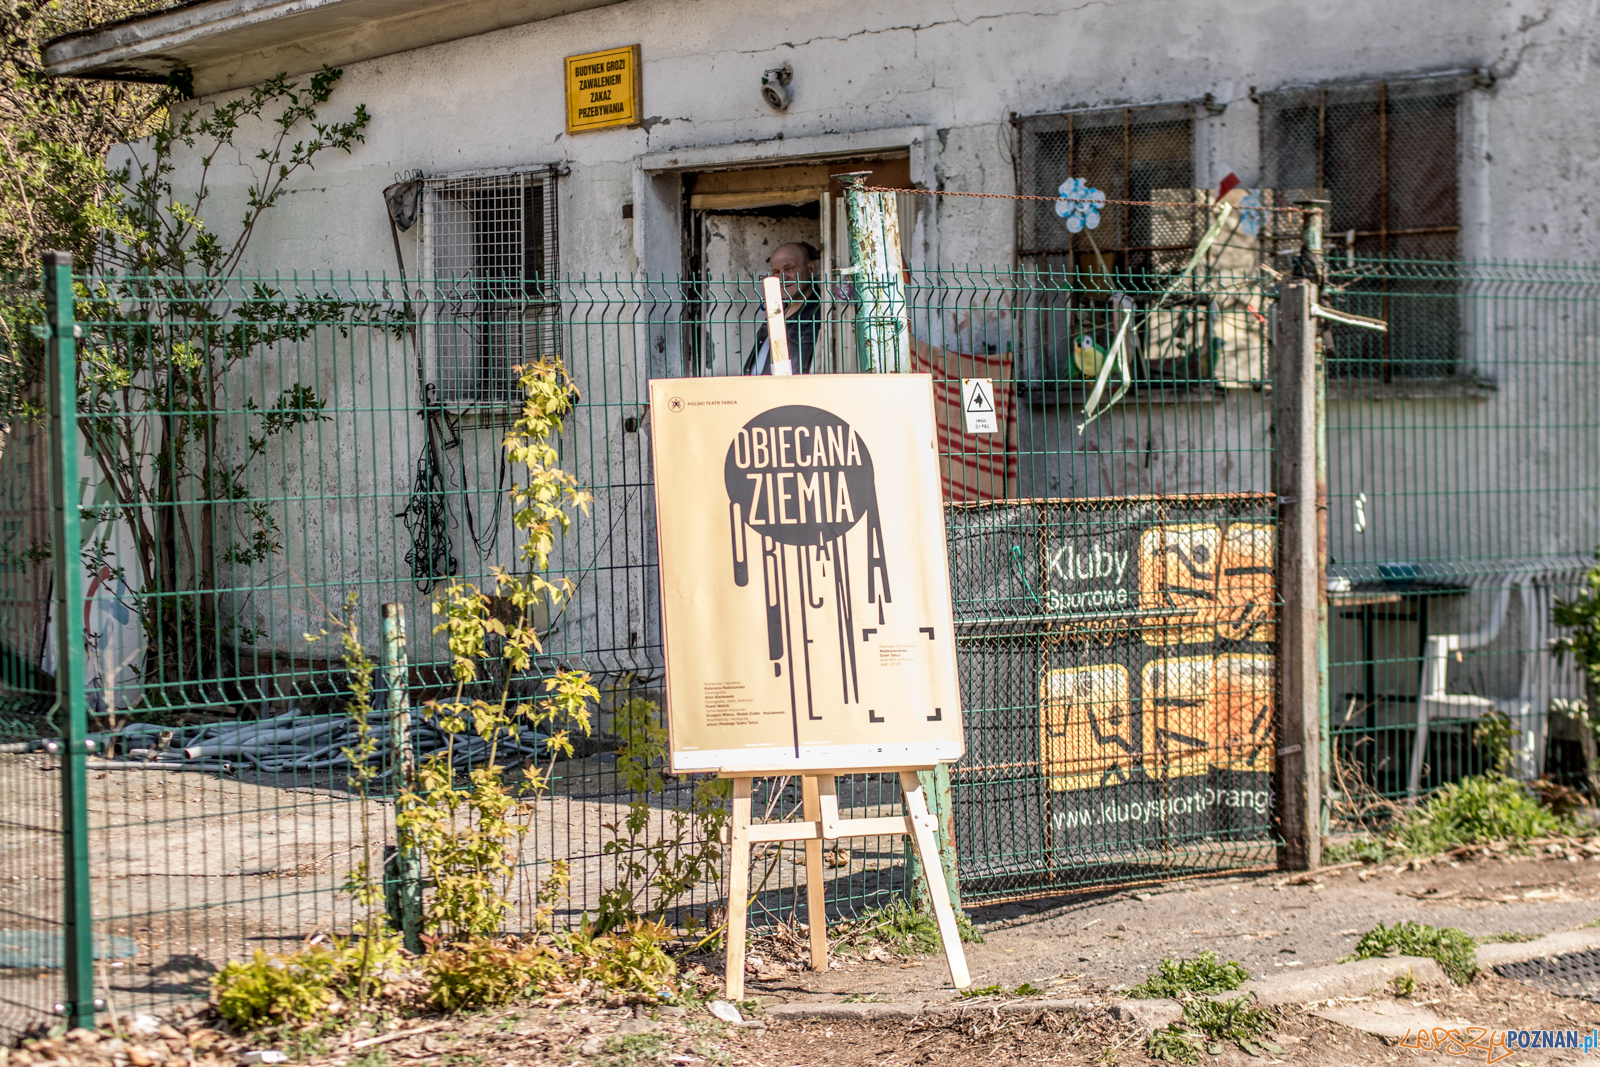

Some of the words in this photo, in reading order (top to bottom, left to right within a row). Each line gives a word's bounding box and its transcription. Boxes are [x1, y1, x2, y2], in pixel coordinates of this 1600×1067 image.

[575, 62, 605, 77] BUDYNEK
[606, 59, 626, 71] GROZI
[579, 74, 622, 90] ZAWALENIEM
[590, 90, 612, 103] ZAKAZ
[578, 102, 624, 118] PRZEBYWANIA
[734, 425, 862, 469] OBIECANA
[746, 471, 854, 526] ZIEMIA
[1047, 544, 1128, 585] Kluby
